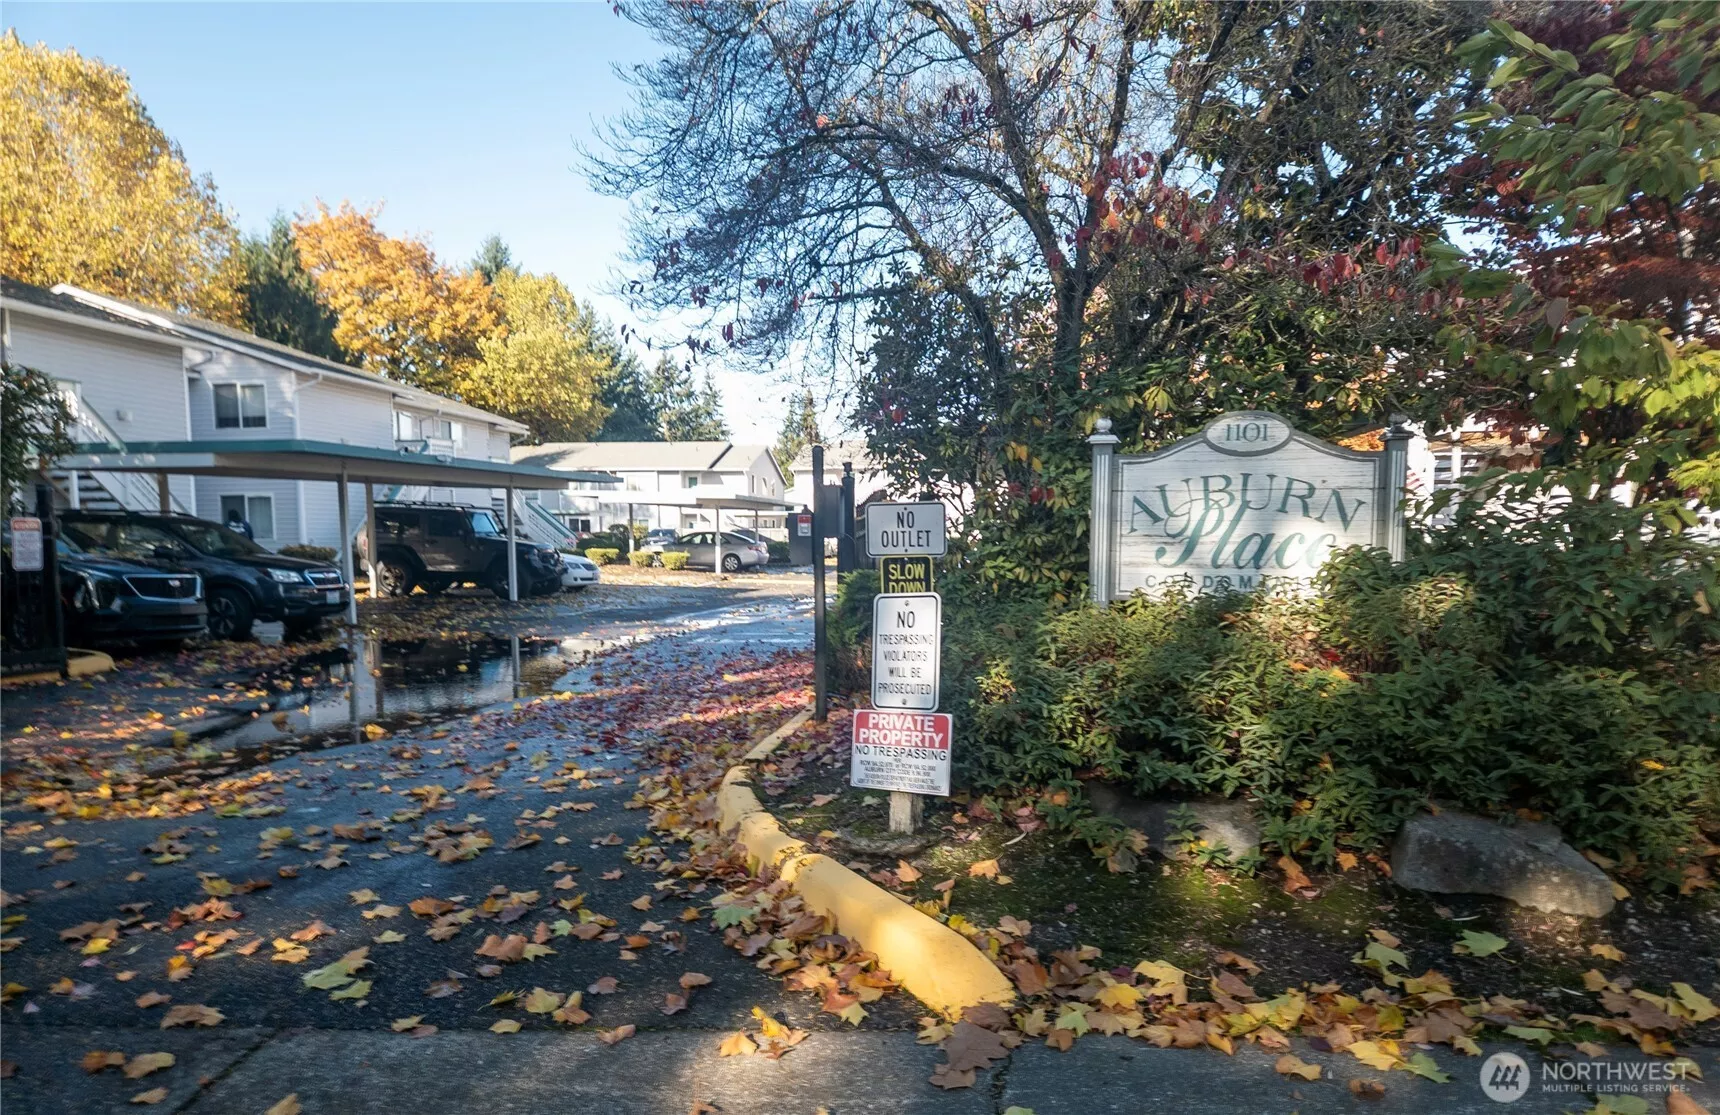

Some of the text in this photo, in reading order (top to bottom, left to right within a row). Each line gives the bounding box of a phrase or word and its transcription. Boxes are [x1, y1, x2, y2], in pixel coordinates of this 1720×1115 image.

[1226, 423, 1268, 443] 1101
[1127, 473, 1367, 532] AUBURN
[896, 511, 915, 529] NO
[881, 530, 932, 548] OUTLET
[1155, 497, 1337, 570] Place
[888, 563, 926, 580] SLOW
[888, 581, 926, 593] DOWN
[896, 610, 916, 629] NO
[878, 633, 934, 645] TRESPASSING
[883, 650, 928, 662] VIOLATORS
[888, 666, 922, 679] WILL BE
[878, 682, 932, 695] PROSECUTED
[868, 713, 935, 732] PRIVATE
[859, 728, 944, 748] PROPERTY
[855, 745, 947, 761] NO TRESPASSING
